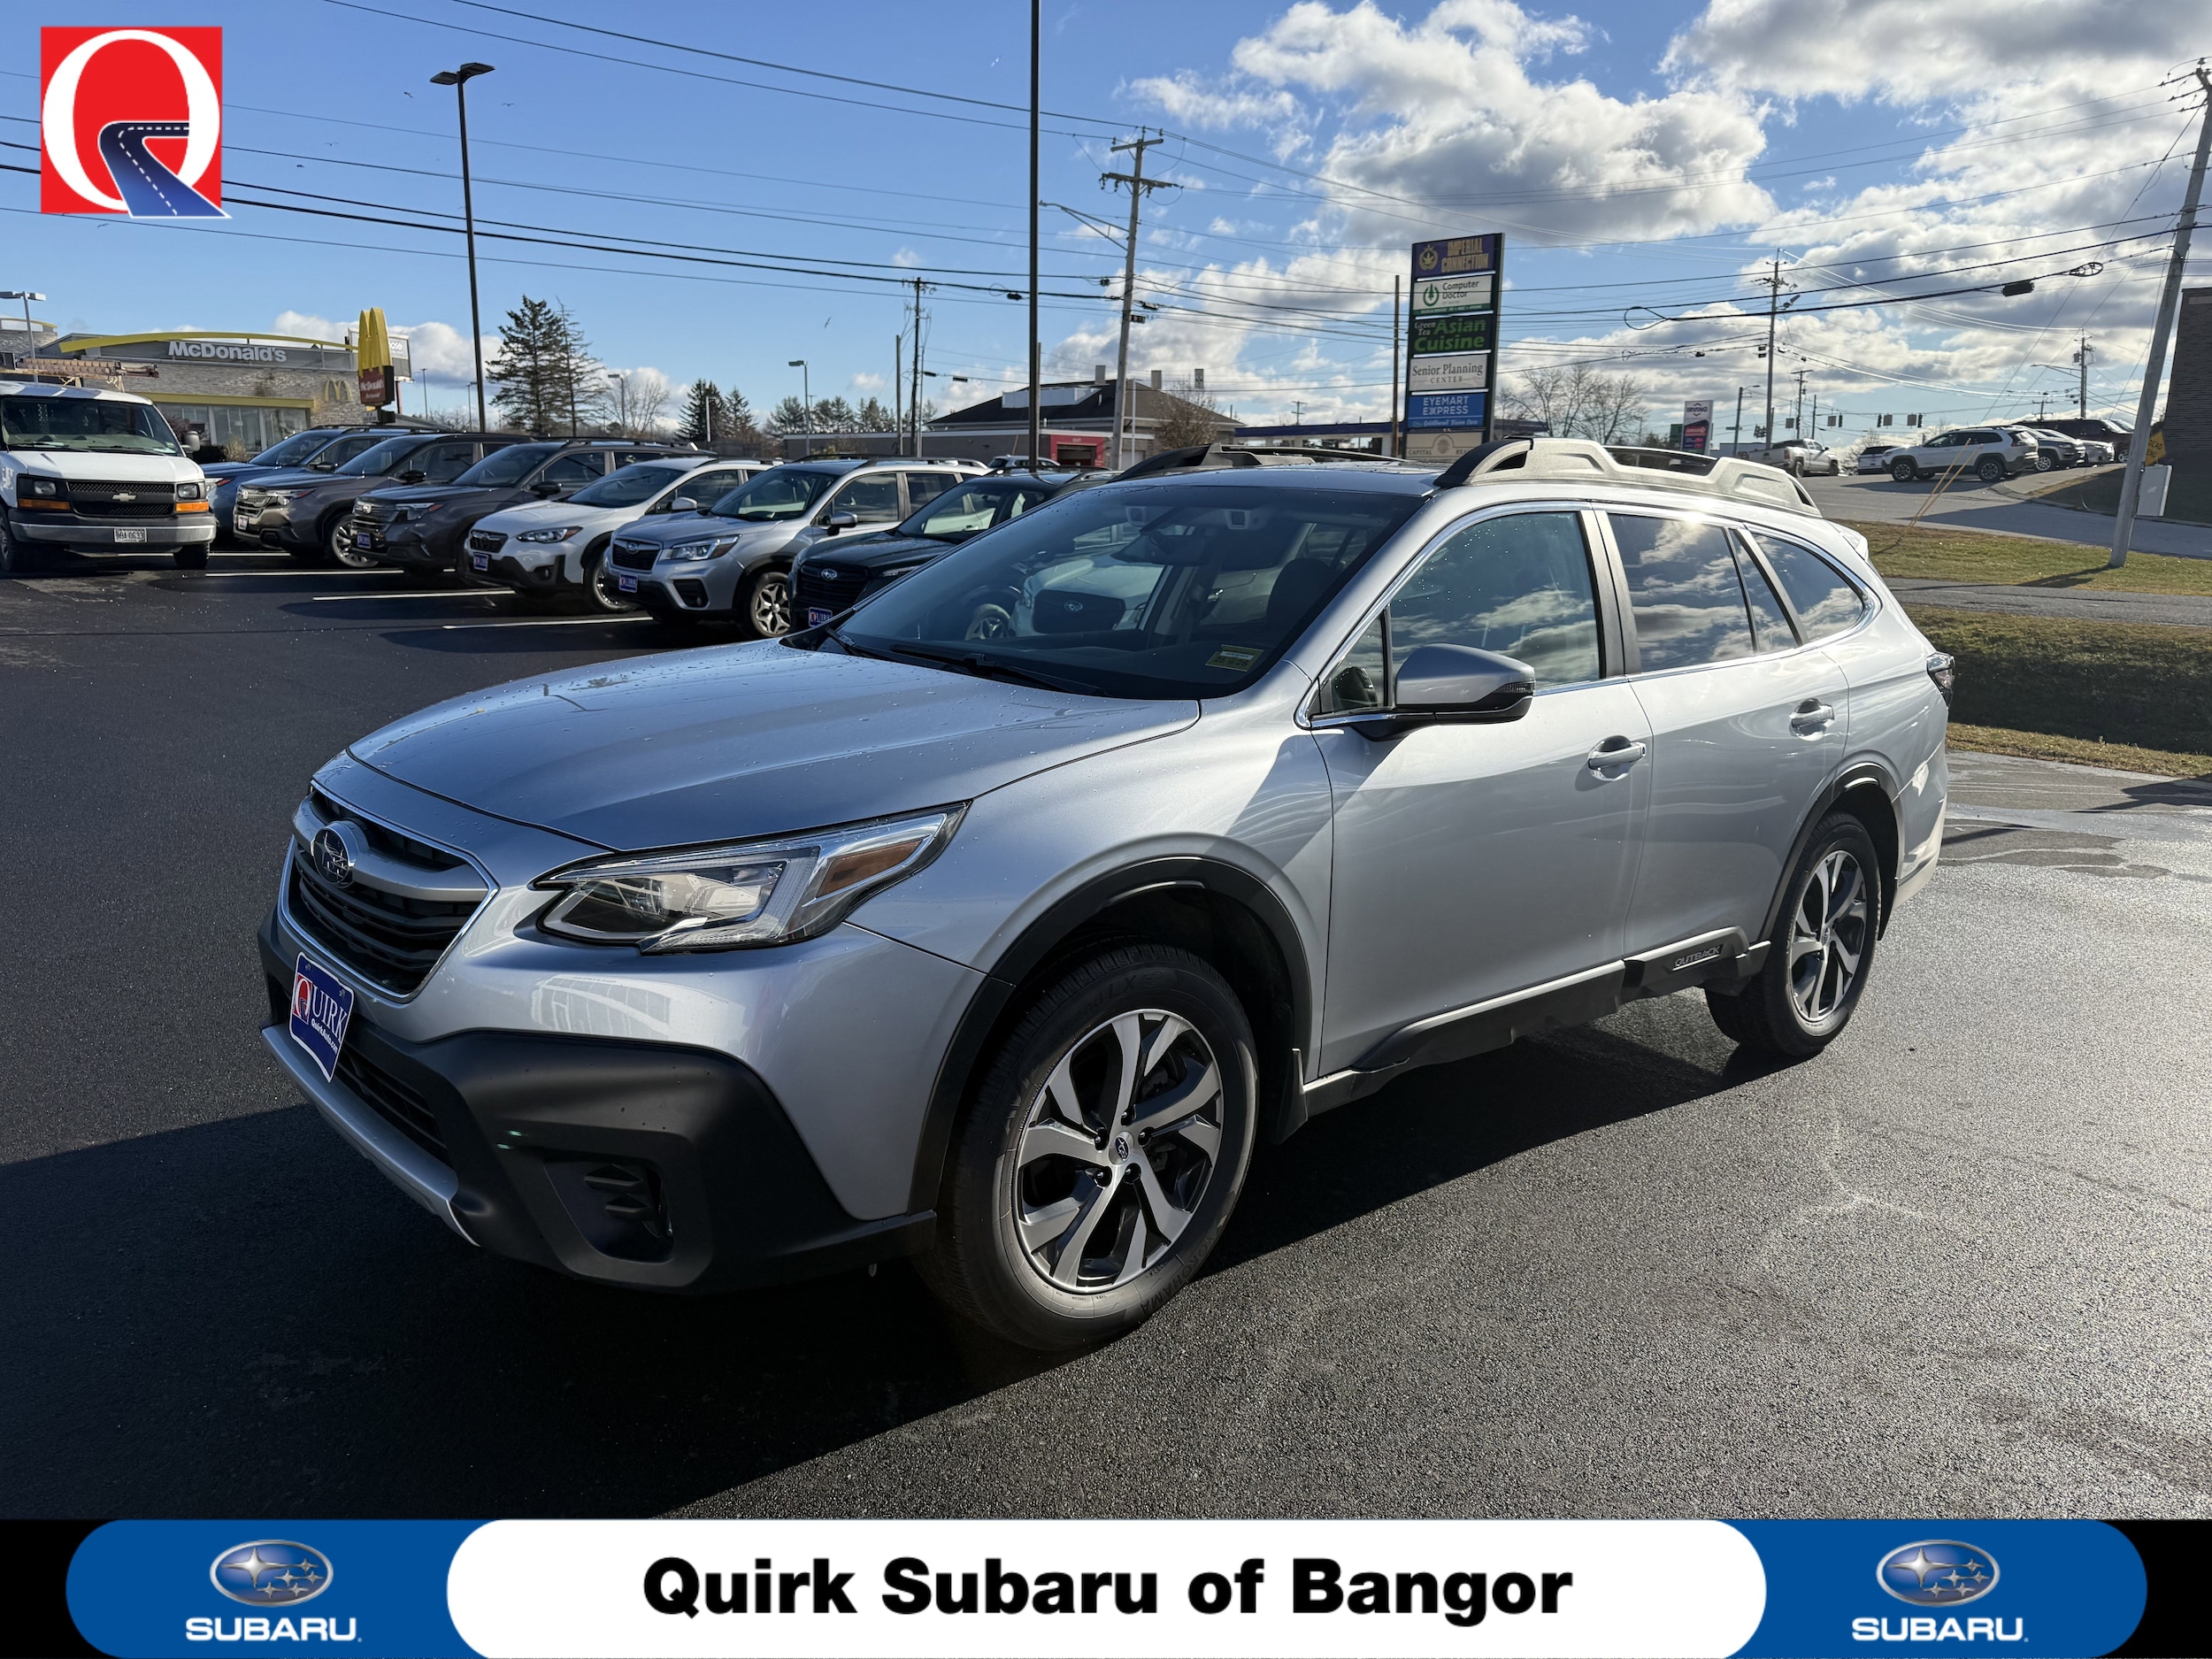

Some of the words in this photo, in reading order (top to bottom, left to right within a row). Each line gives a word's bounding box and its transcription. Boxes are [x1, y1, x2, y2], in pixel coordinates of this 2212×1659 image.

[1448, 238, 1483, 256] IMPERIAL
[1440, 253, 1488, 273] CONNECTION
[1442, 280, 1479, 291] Computer
[1442, 290, 1468, 299] Doctor
[1433, 319, 1486, 334] Asian
[1414, 334, 1486, 352] Cuisine
[168, 341, 288, 363] McDonald's
[1412, 365, 1441, 377] Senior
[1442, 363, 1483, 376] Planning
[1423, 396, 1470, 406] EYEMART
[1423, 405, 1469, 416] EXPRESS
[1675, 945, 1720, 967] OUTBACK
[1140, 1235, 1216, 1317] YOKOHAMA
